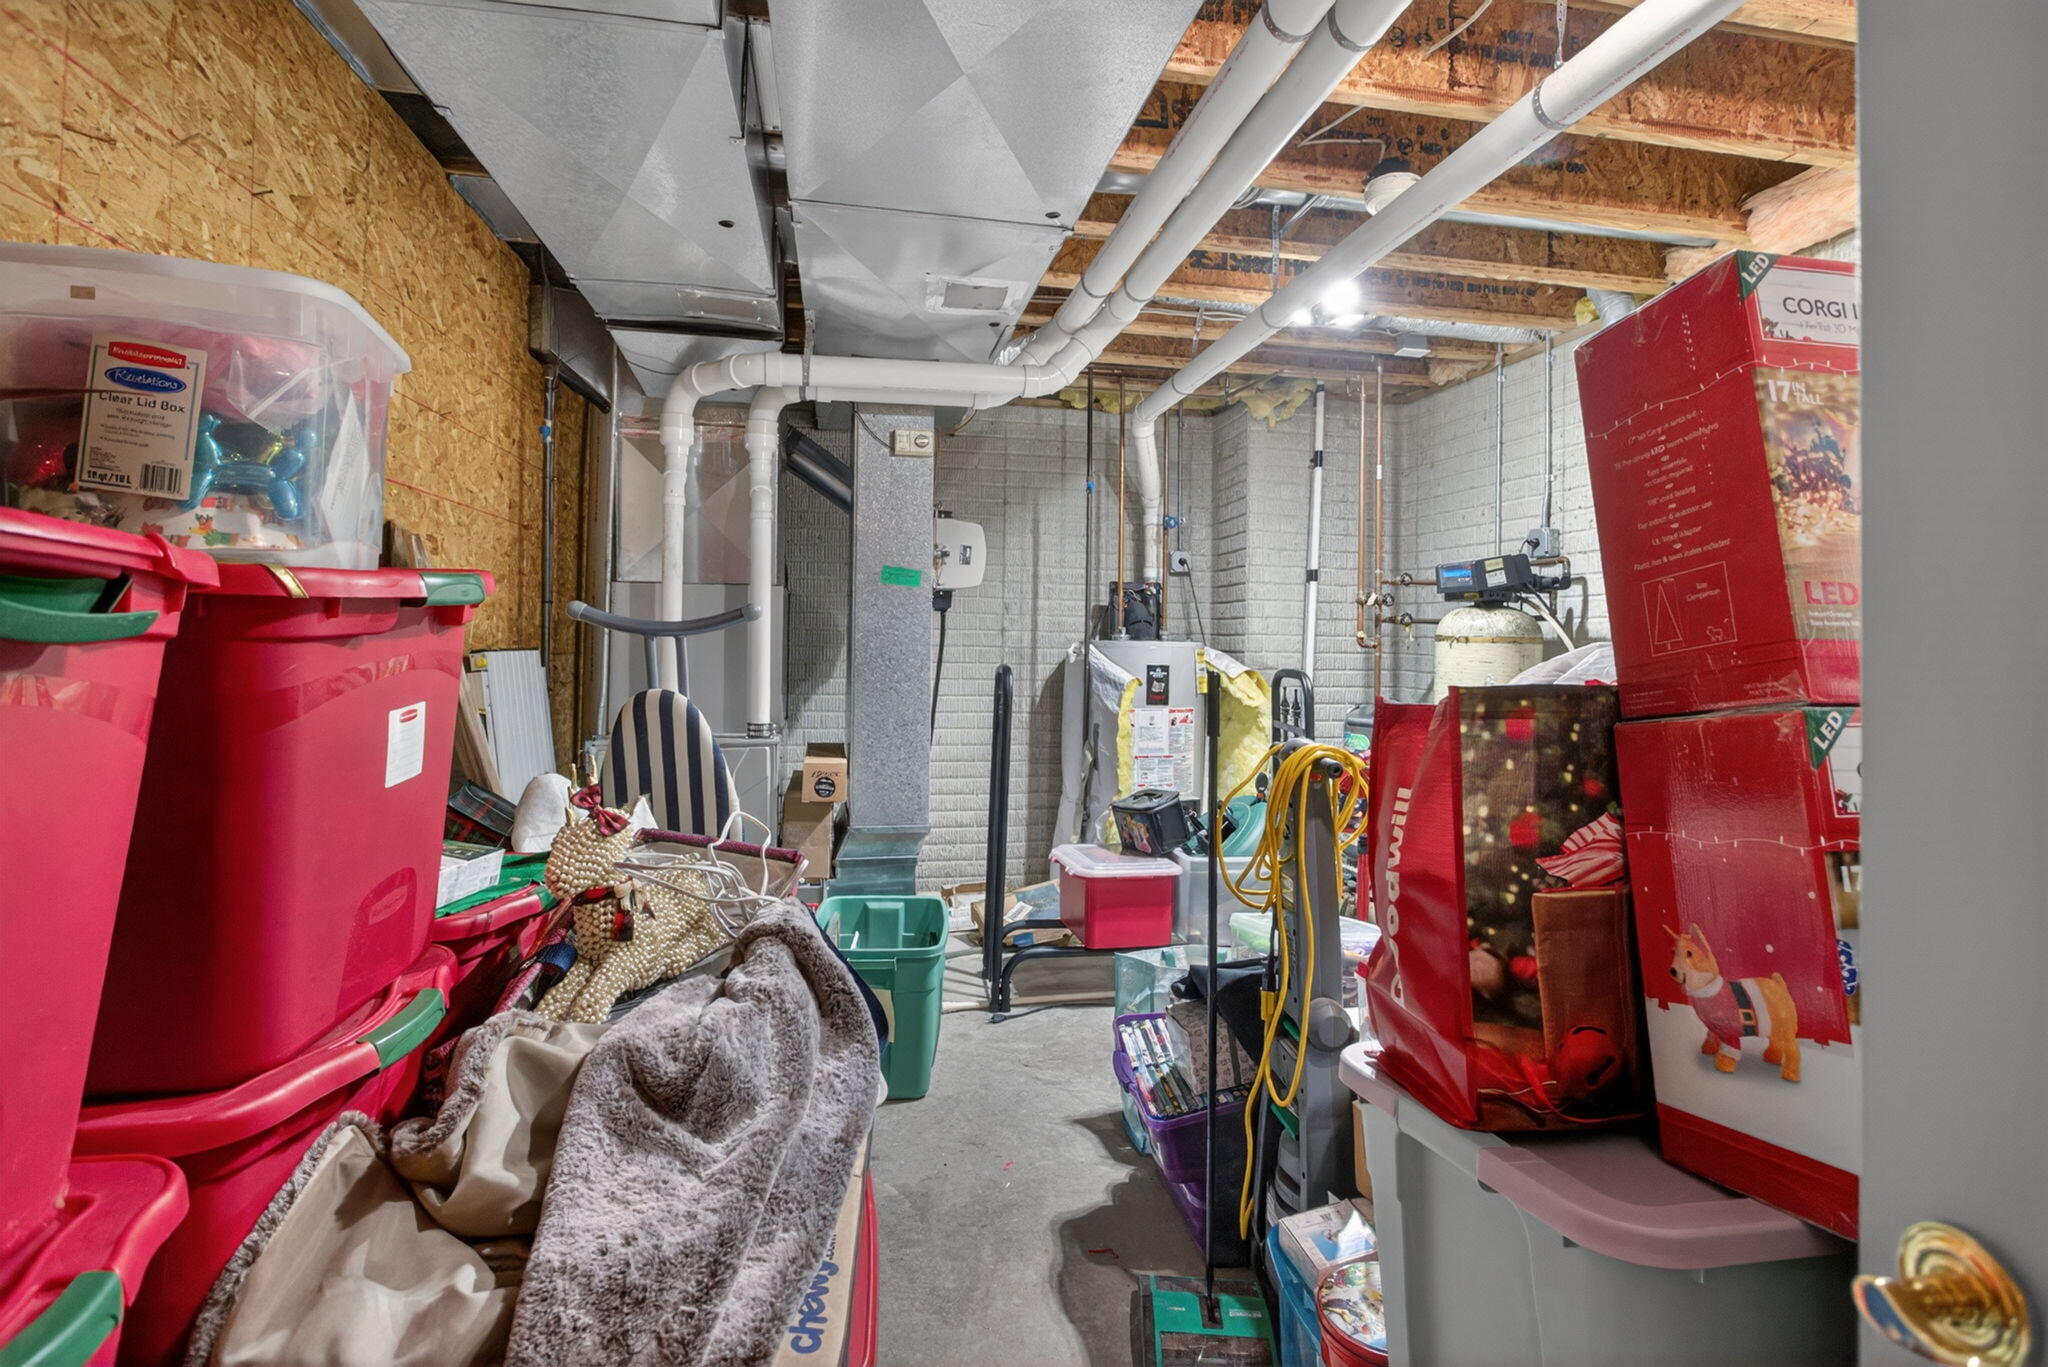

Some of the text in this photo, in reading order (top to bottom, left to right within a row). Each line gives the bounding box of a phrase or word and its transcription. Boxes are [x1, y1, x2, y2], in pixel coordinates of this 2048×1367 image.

[1741, 254, 1770, 284] LED
[1783, 296, 1847, 319] CORGI
[99, 391, 186, 414] Clear Lid Box
[1768, 379, 1792, 402] 17
[1804, 580, 1859, 606] LED
[1813, 711, 1842, 750] LED
